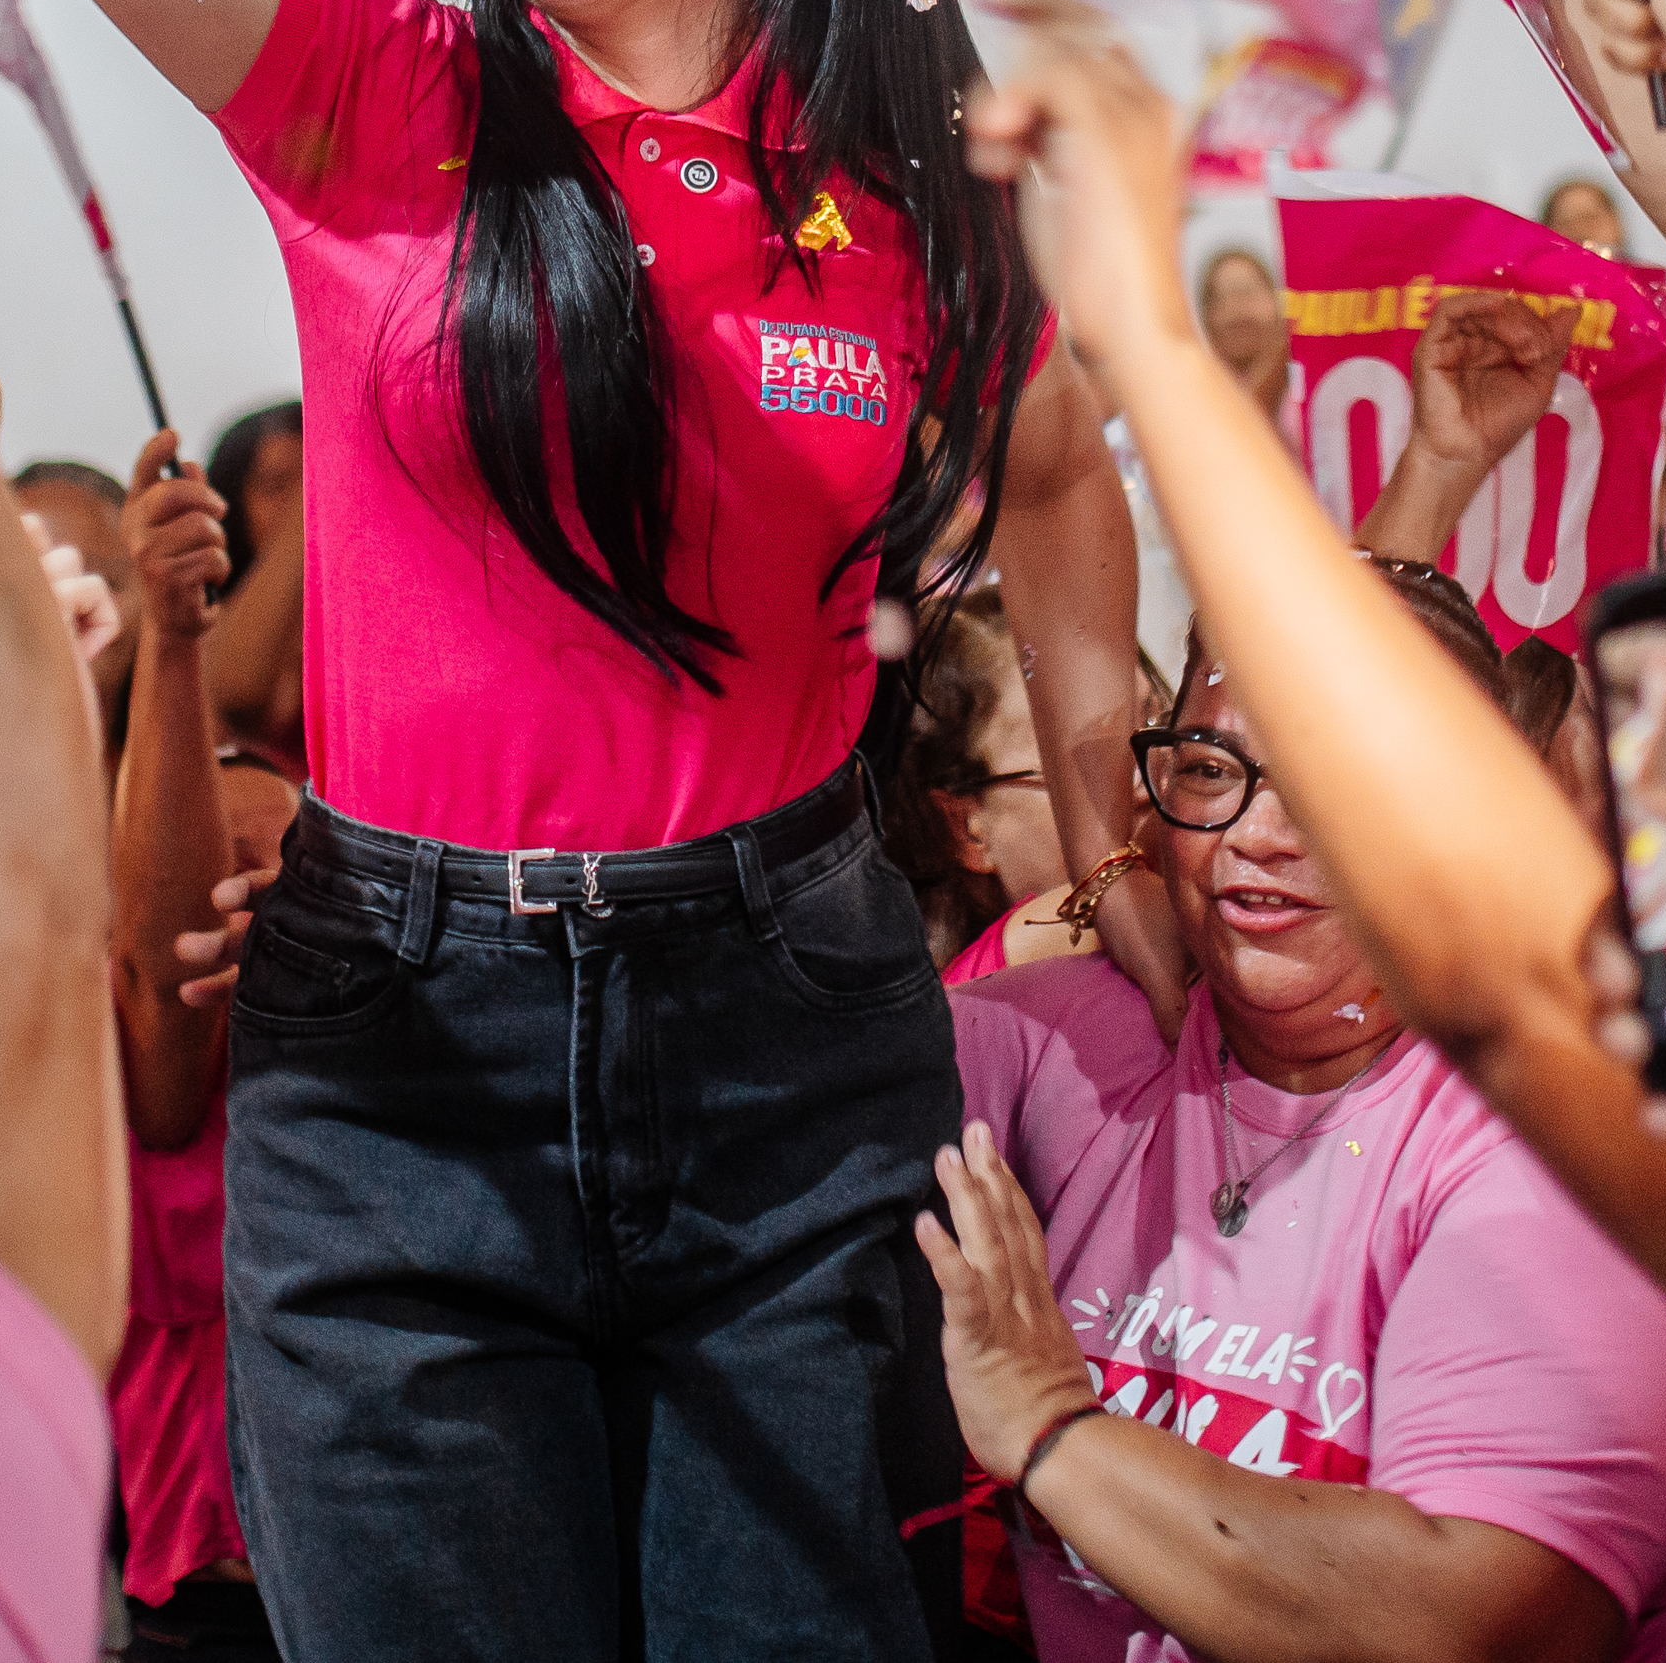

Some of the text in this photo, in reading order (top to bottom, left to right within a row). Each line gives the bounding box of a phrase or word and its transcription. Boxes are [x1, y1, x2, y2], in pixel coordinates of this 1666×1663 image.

[759, 318, 827, 338] DEPUTADA
[760, 335, 888, 385] PAULA
[759, 383, 887, 426] 55000
[761, 365, 888, 402] PRATA
[1105, 1286, 1163, 1347] TÔ
[1204, 1323, 1295, 1385] ELA
